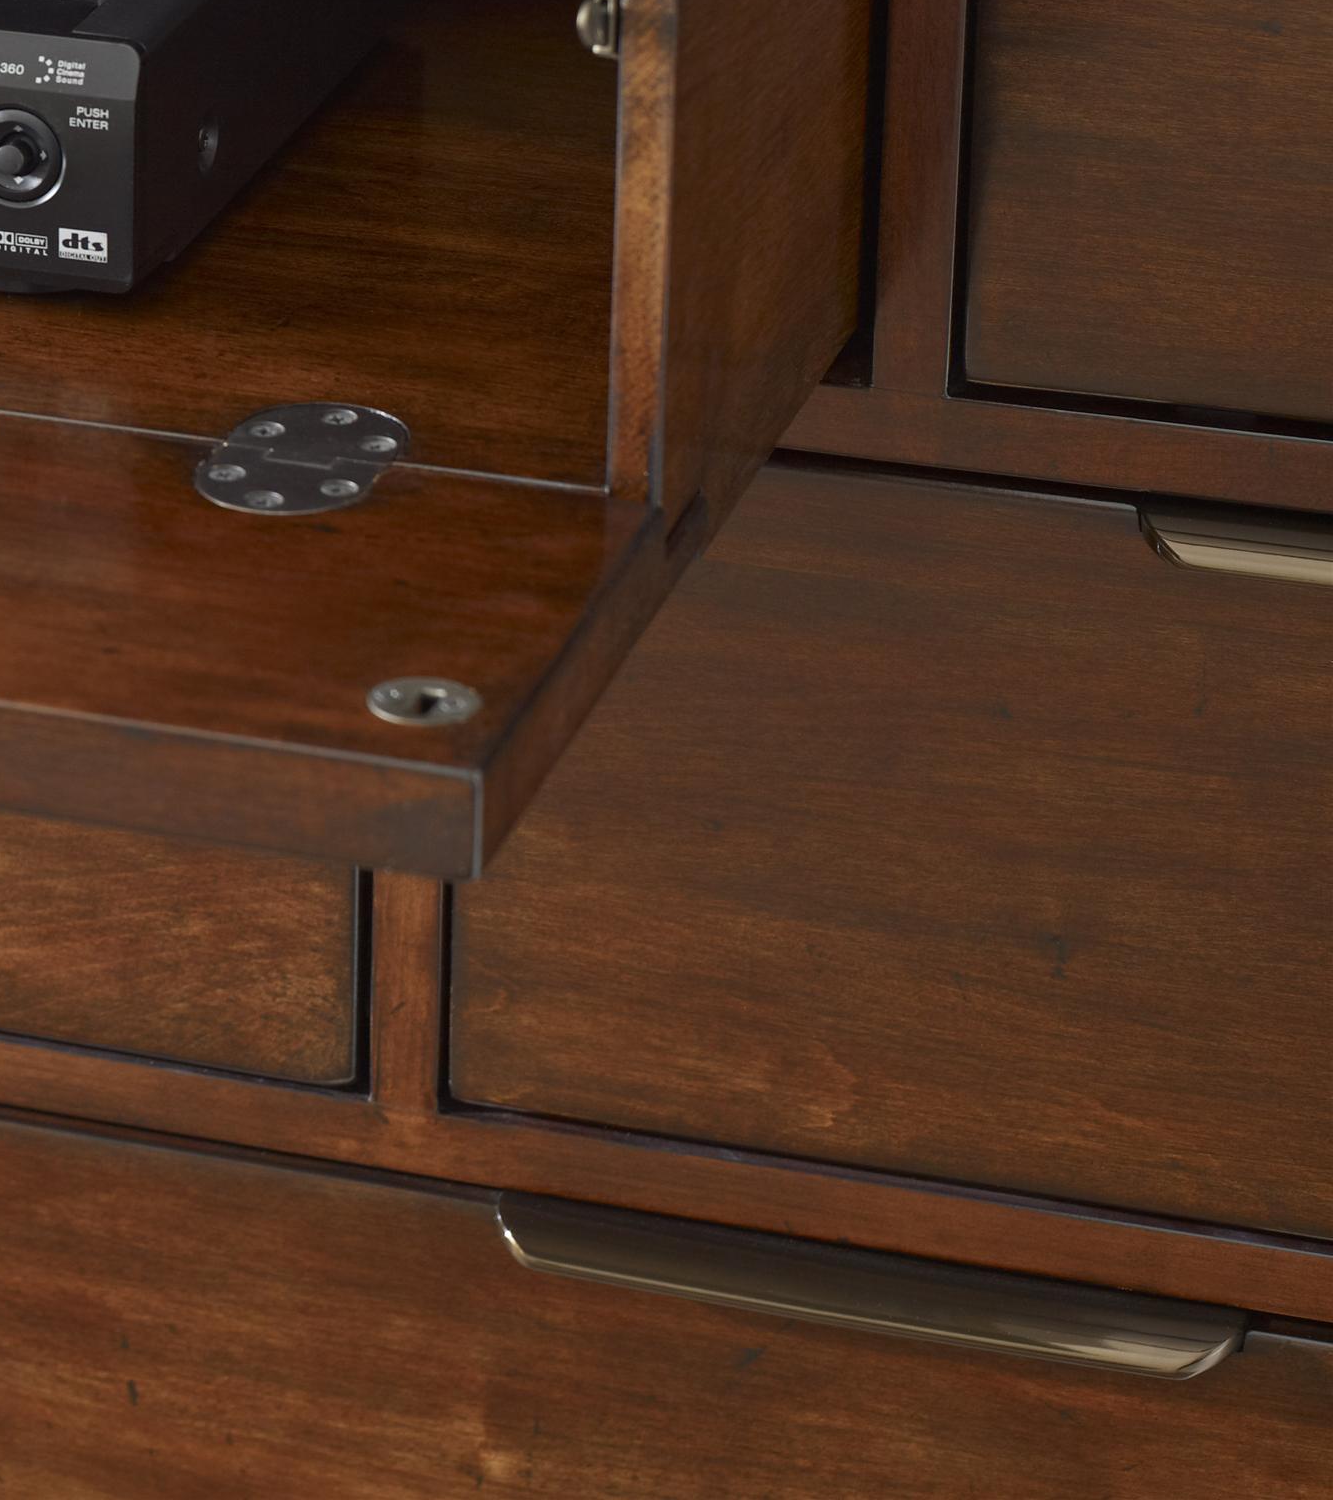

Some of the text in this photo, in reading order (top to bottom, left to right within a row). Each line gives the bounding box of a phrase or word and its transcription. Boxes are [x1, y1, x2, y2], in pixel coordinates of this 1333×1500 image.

[57, 60, 86, 70] Digital
[55, 75, 84, 86] Sound
[76, 106, 109, 119] PUSH
[69, 117, 109, 131] ENTER
[18, 236, 46, 246] DOLBY
[61, 232, 105, 252] dts
